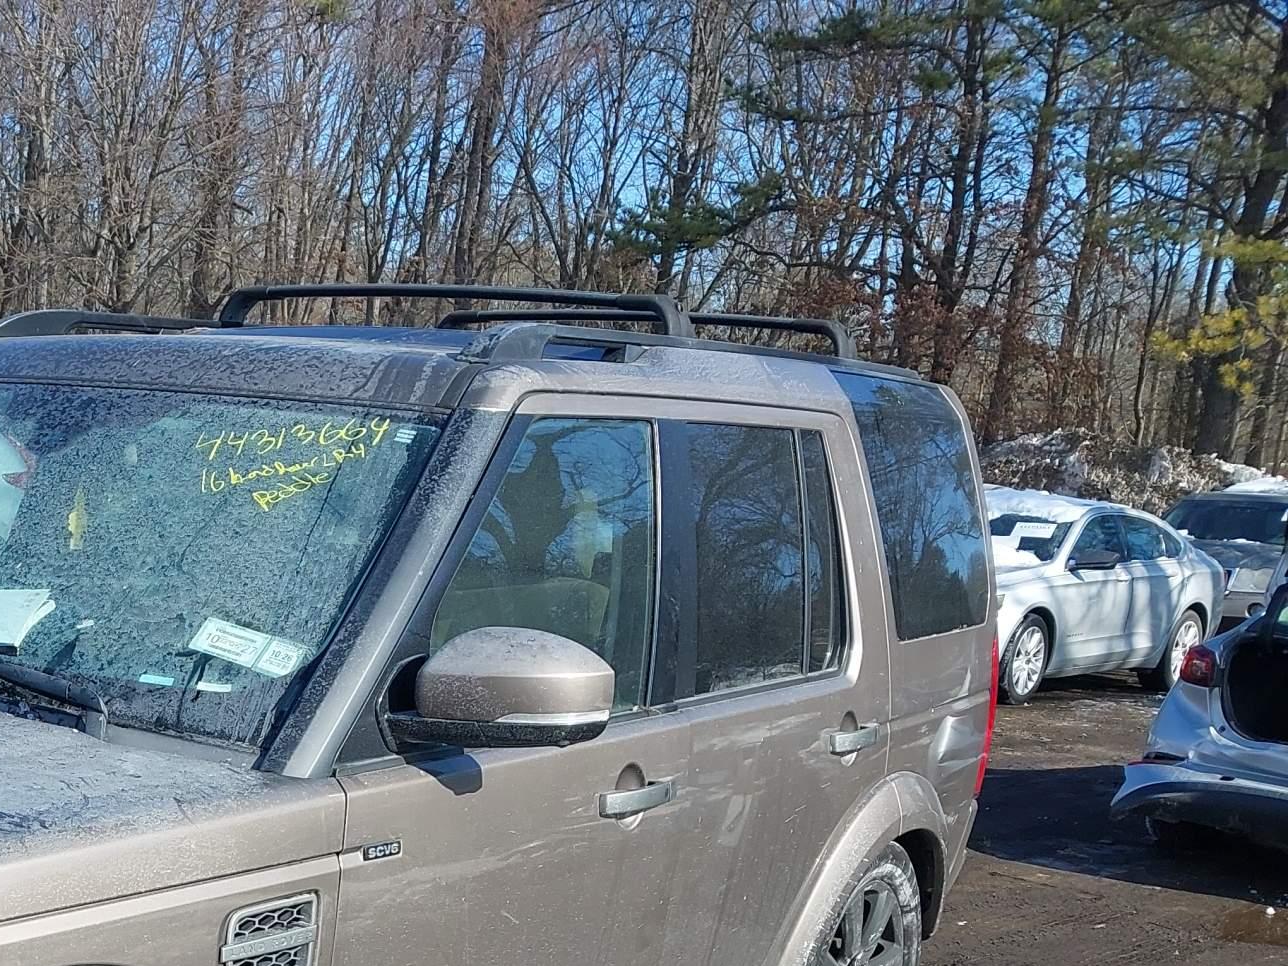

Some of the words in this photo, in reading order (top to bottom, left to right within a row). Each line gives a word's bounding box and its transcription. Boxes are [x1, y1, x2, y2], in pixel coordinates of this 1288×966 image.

[195, 416, 391, 461] 44313664
[200, 468, 225, 493] 16
[367, 842, 400, 859] SCV6
